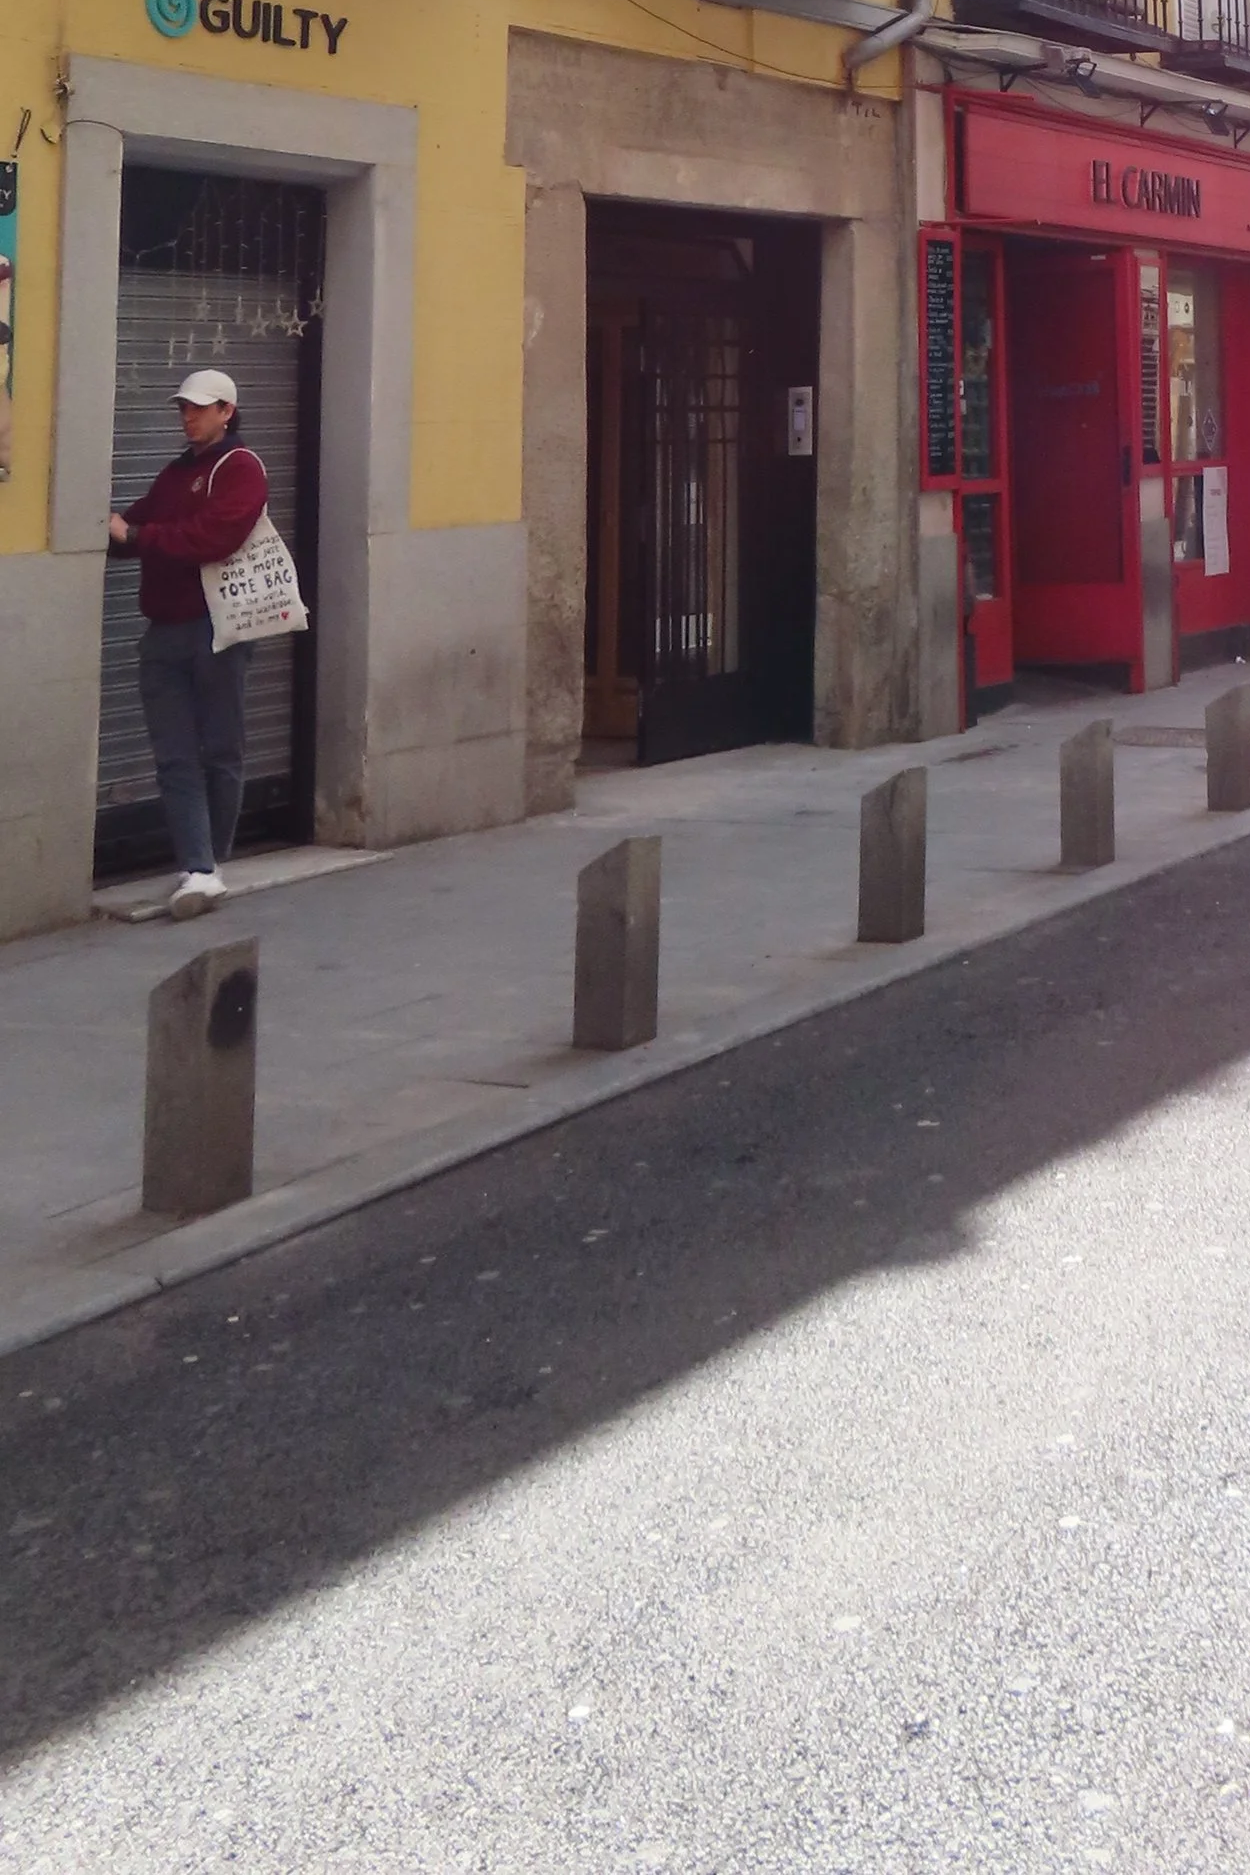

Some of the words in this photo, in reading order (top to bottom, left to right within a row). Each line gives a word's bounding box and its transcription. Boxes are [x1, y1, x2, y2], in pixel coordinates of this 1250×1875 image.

[1091, 159, 1116, 205] EL
[1121, 165, 1202, 219] CARMIN
[219, 578, 257, 600] TOTE
[264, 569, 293, 588] BAG
[221, 568, 245, 582] one
[253, 556, 284, 574] more
